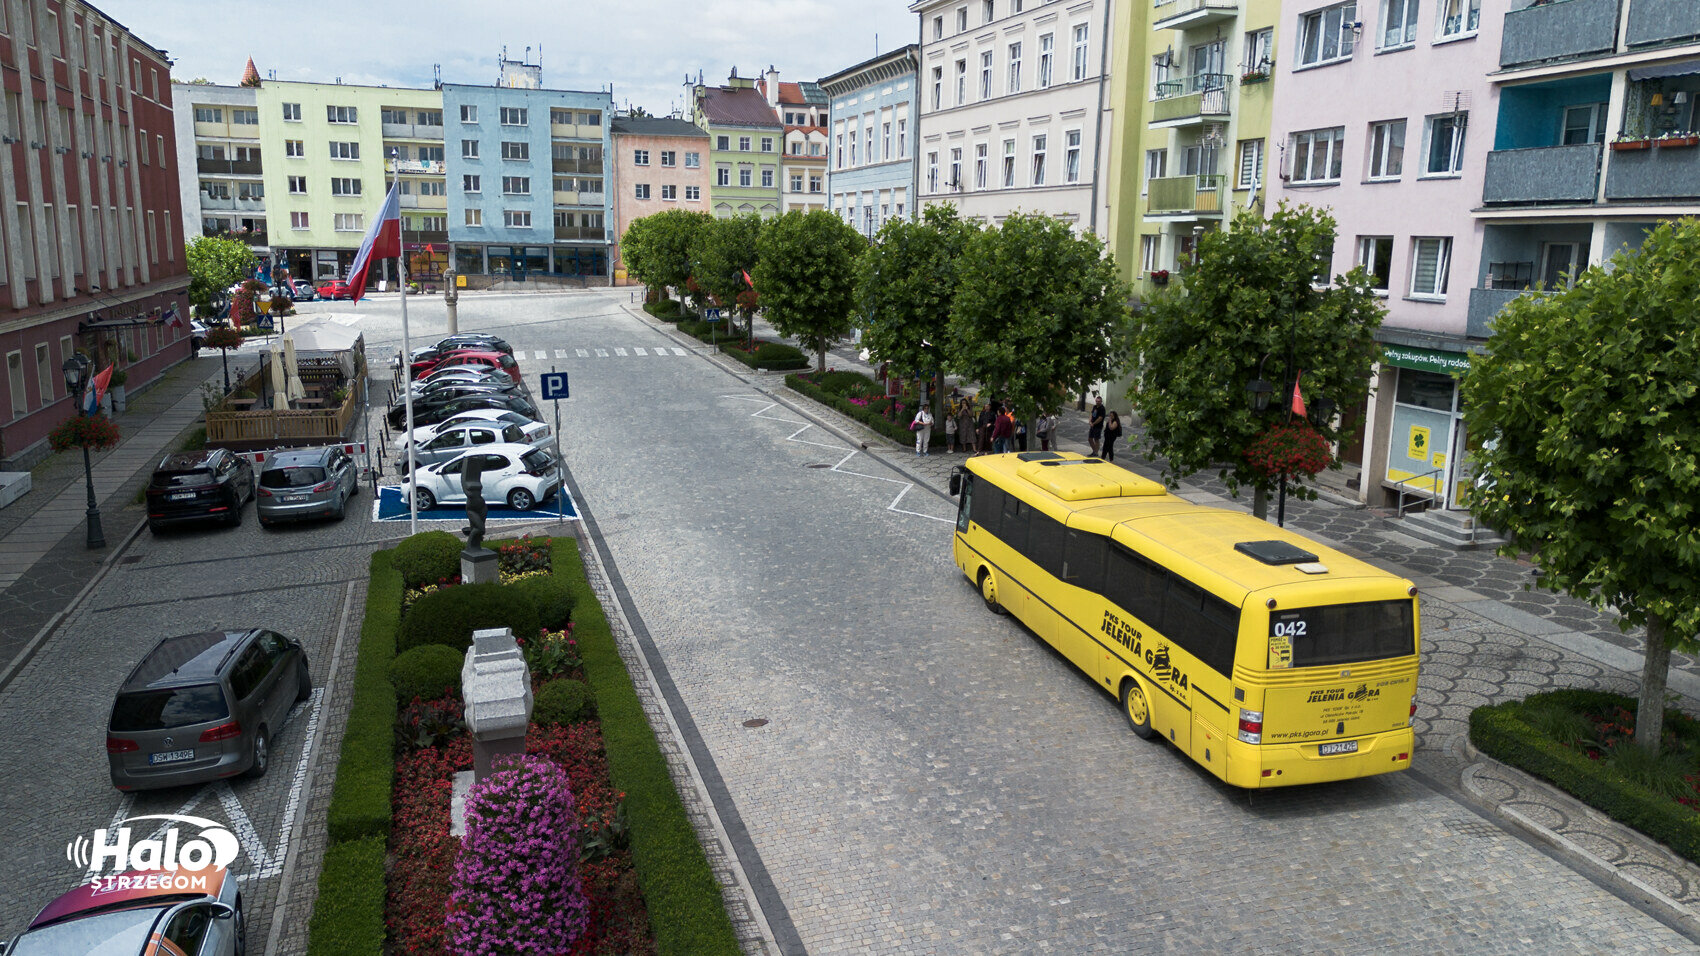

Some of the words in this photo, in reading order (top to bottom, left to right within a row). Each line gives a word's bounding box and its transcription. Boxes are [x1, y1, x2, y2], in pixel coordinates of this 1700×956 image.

[547, 376, 563, 397] P
[1104, 610, 1119, 625] PKS
[1120, 620, 1143, 641] TOUR
[1274, 620, 1307, 637] 042
[1101, 618, 1142, 658] JELENIA
[1307, 692, 1344, 703] JELENIA
[152, 752, 168, 763] DSW
